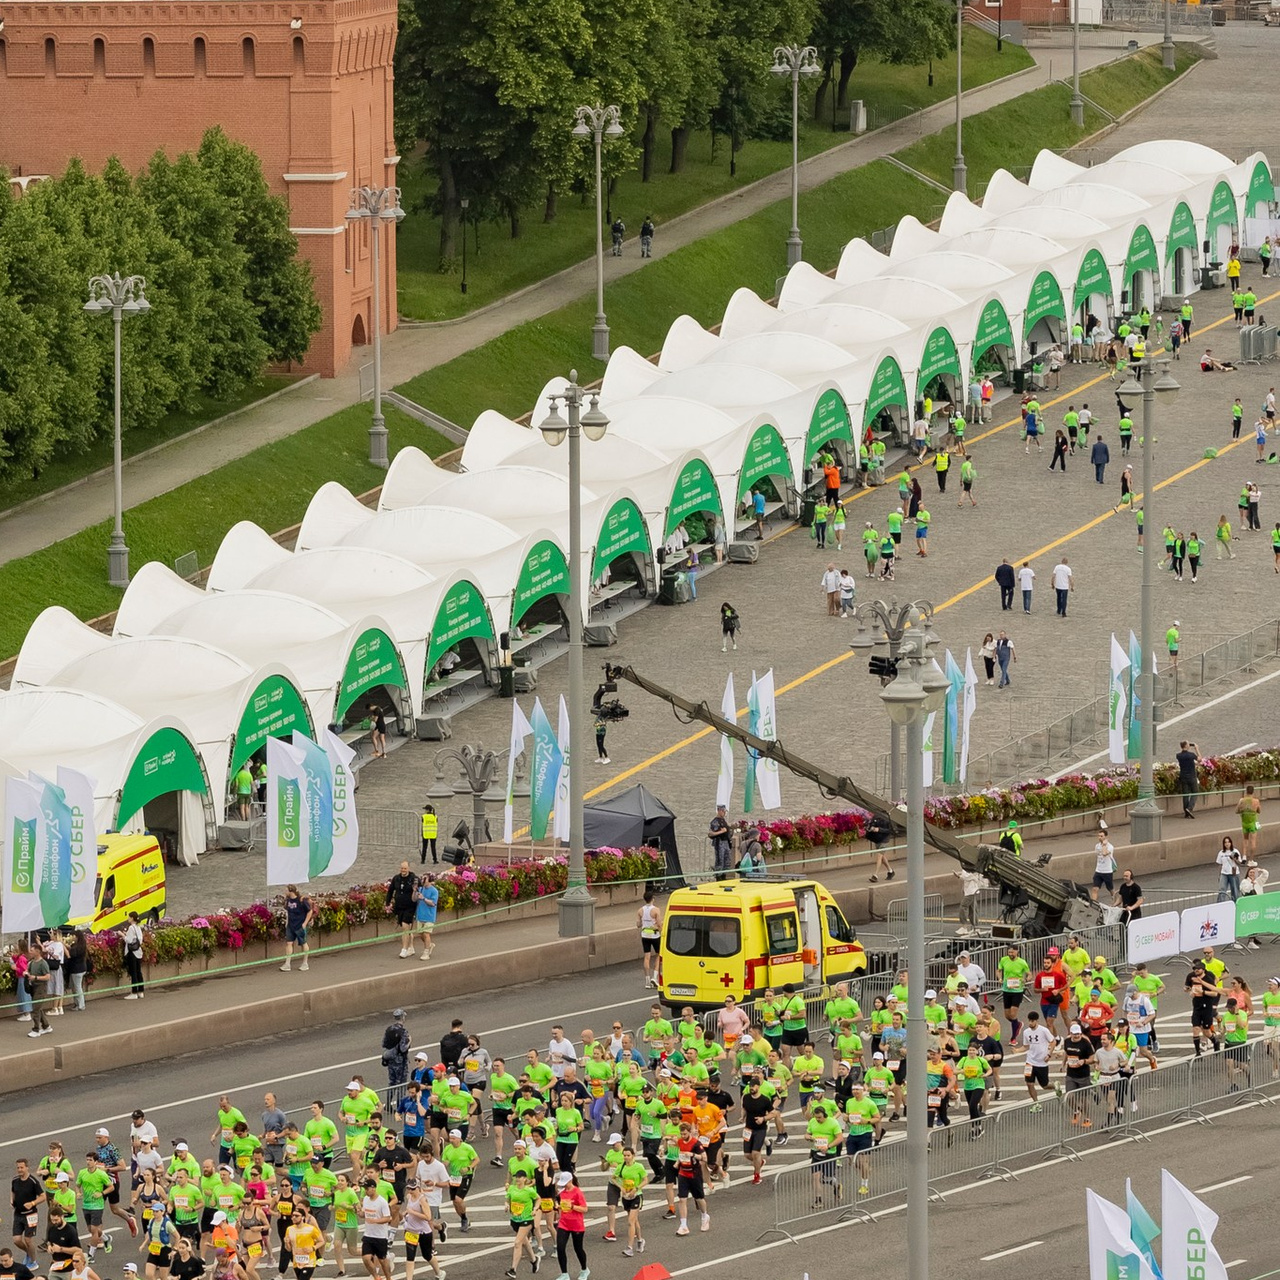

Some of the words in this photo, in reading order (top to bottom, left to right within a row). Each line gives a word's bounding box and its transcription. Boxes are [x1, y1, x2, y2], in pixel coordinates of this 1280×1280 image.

[283, 785, 295, 825] Прайм
[334, 764, 347, 812] СБЕР
[18, 827, 31, 869] Прайм
[70, 805, 84, 856] СБЕР
[50, 839, 60, 890] марафон
